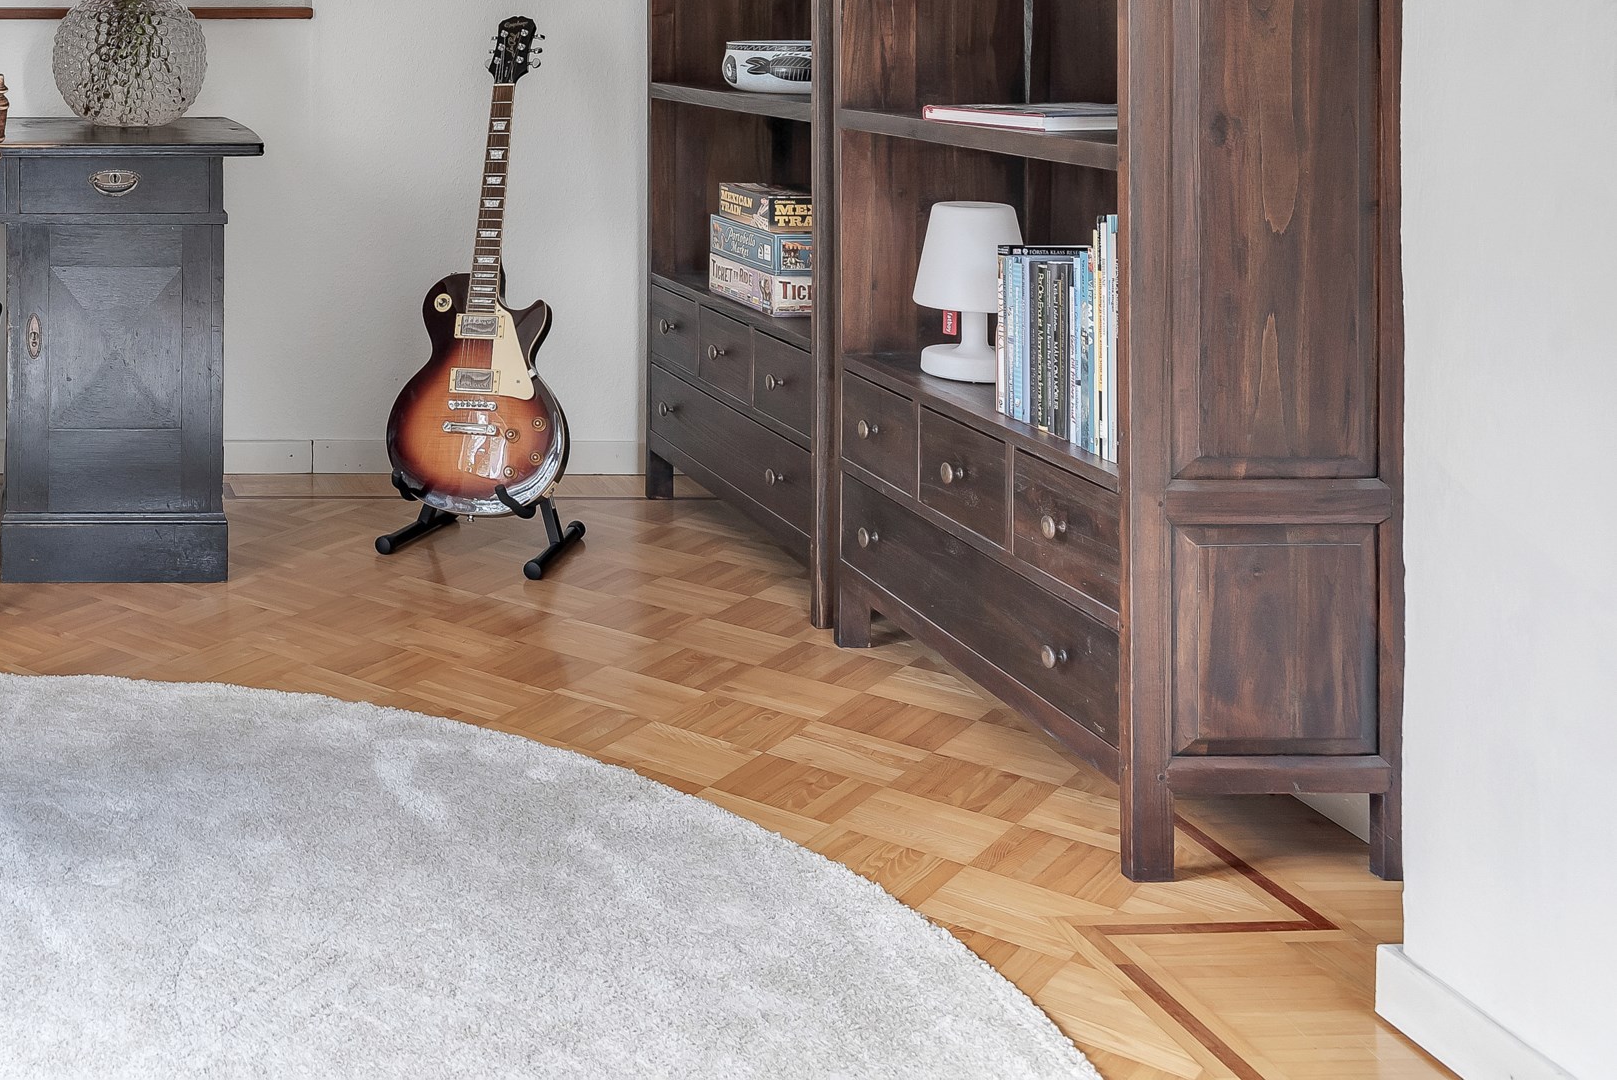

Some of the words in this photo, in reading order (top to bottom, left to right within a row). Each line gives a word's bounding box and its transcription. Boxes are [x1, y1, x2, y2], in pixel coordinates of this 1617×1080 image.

[721, 190, 753, 208] MEXICAN
[721, 201, 742, 216] TRAIN
[725, 226, 756, 247] Portobello
